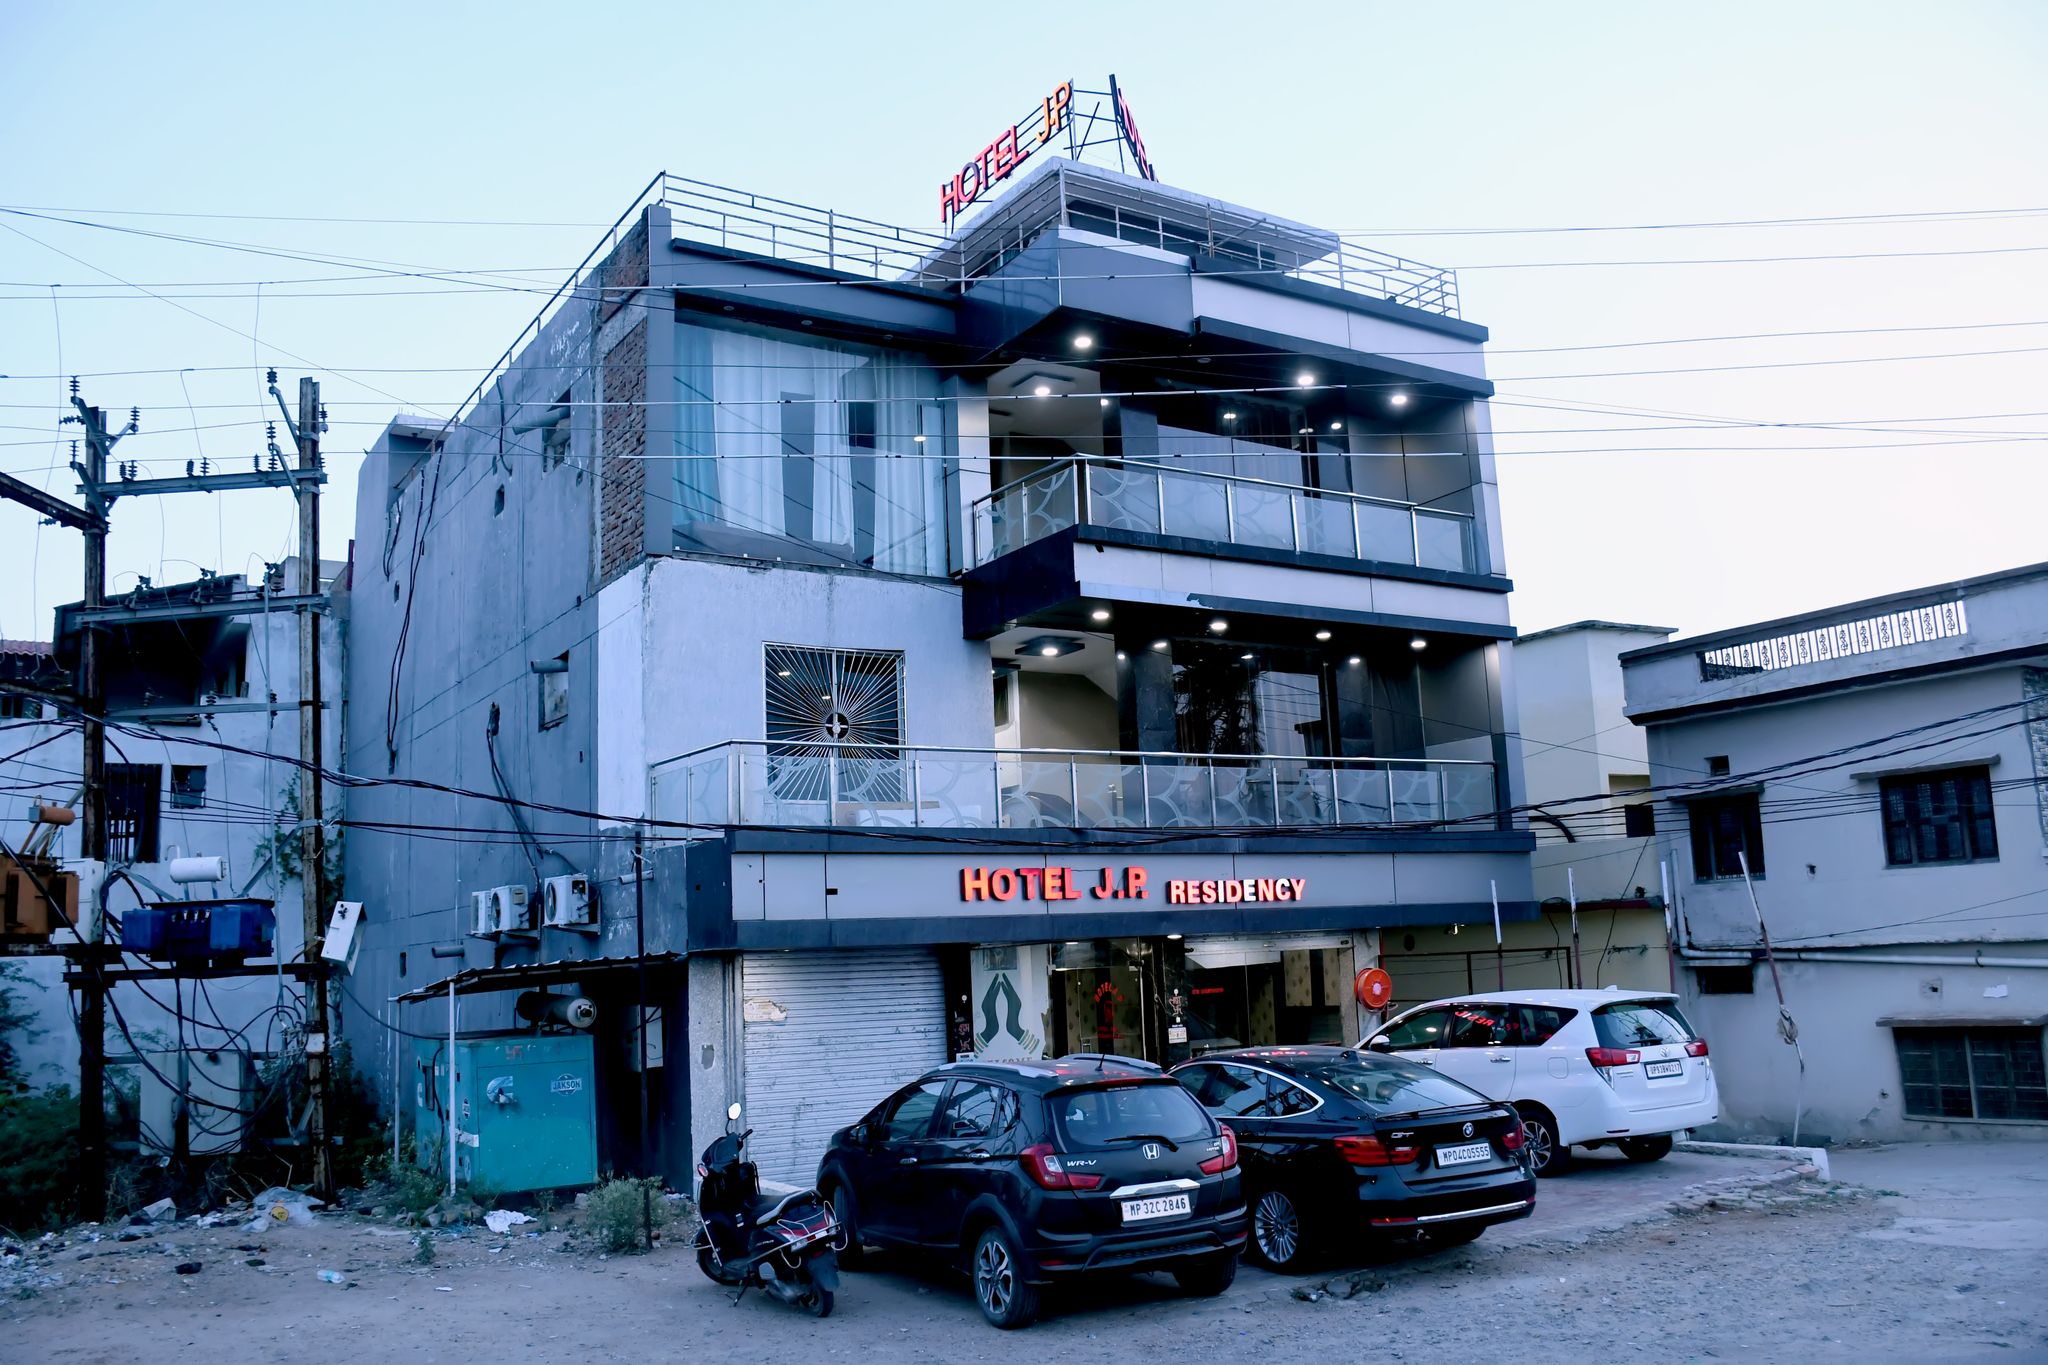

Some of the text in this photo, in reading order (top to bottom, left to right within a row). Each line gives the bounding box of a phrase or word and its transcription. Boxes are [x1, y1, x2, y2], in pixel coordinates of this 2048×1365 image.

[940, 125, 1030, 223] HOTEL
[960, 867, 1082, 901] HOTEL
[1166, 877, 1307, 904] RESIDENCY
[553, 1079, 582, 1091] JAKSON
[1066, 1159, 1097, 1167] WR-V
